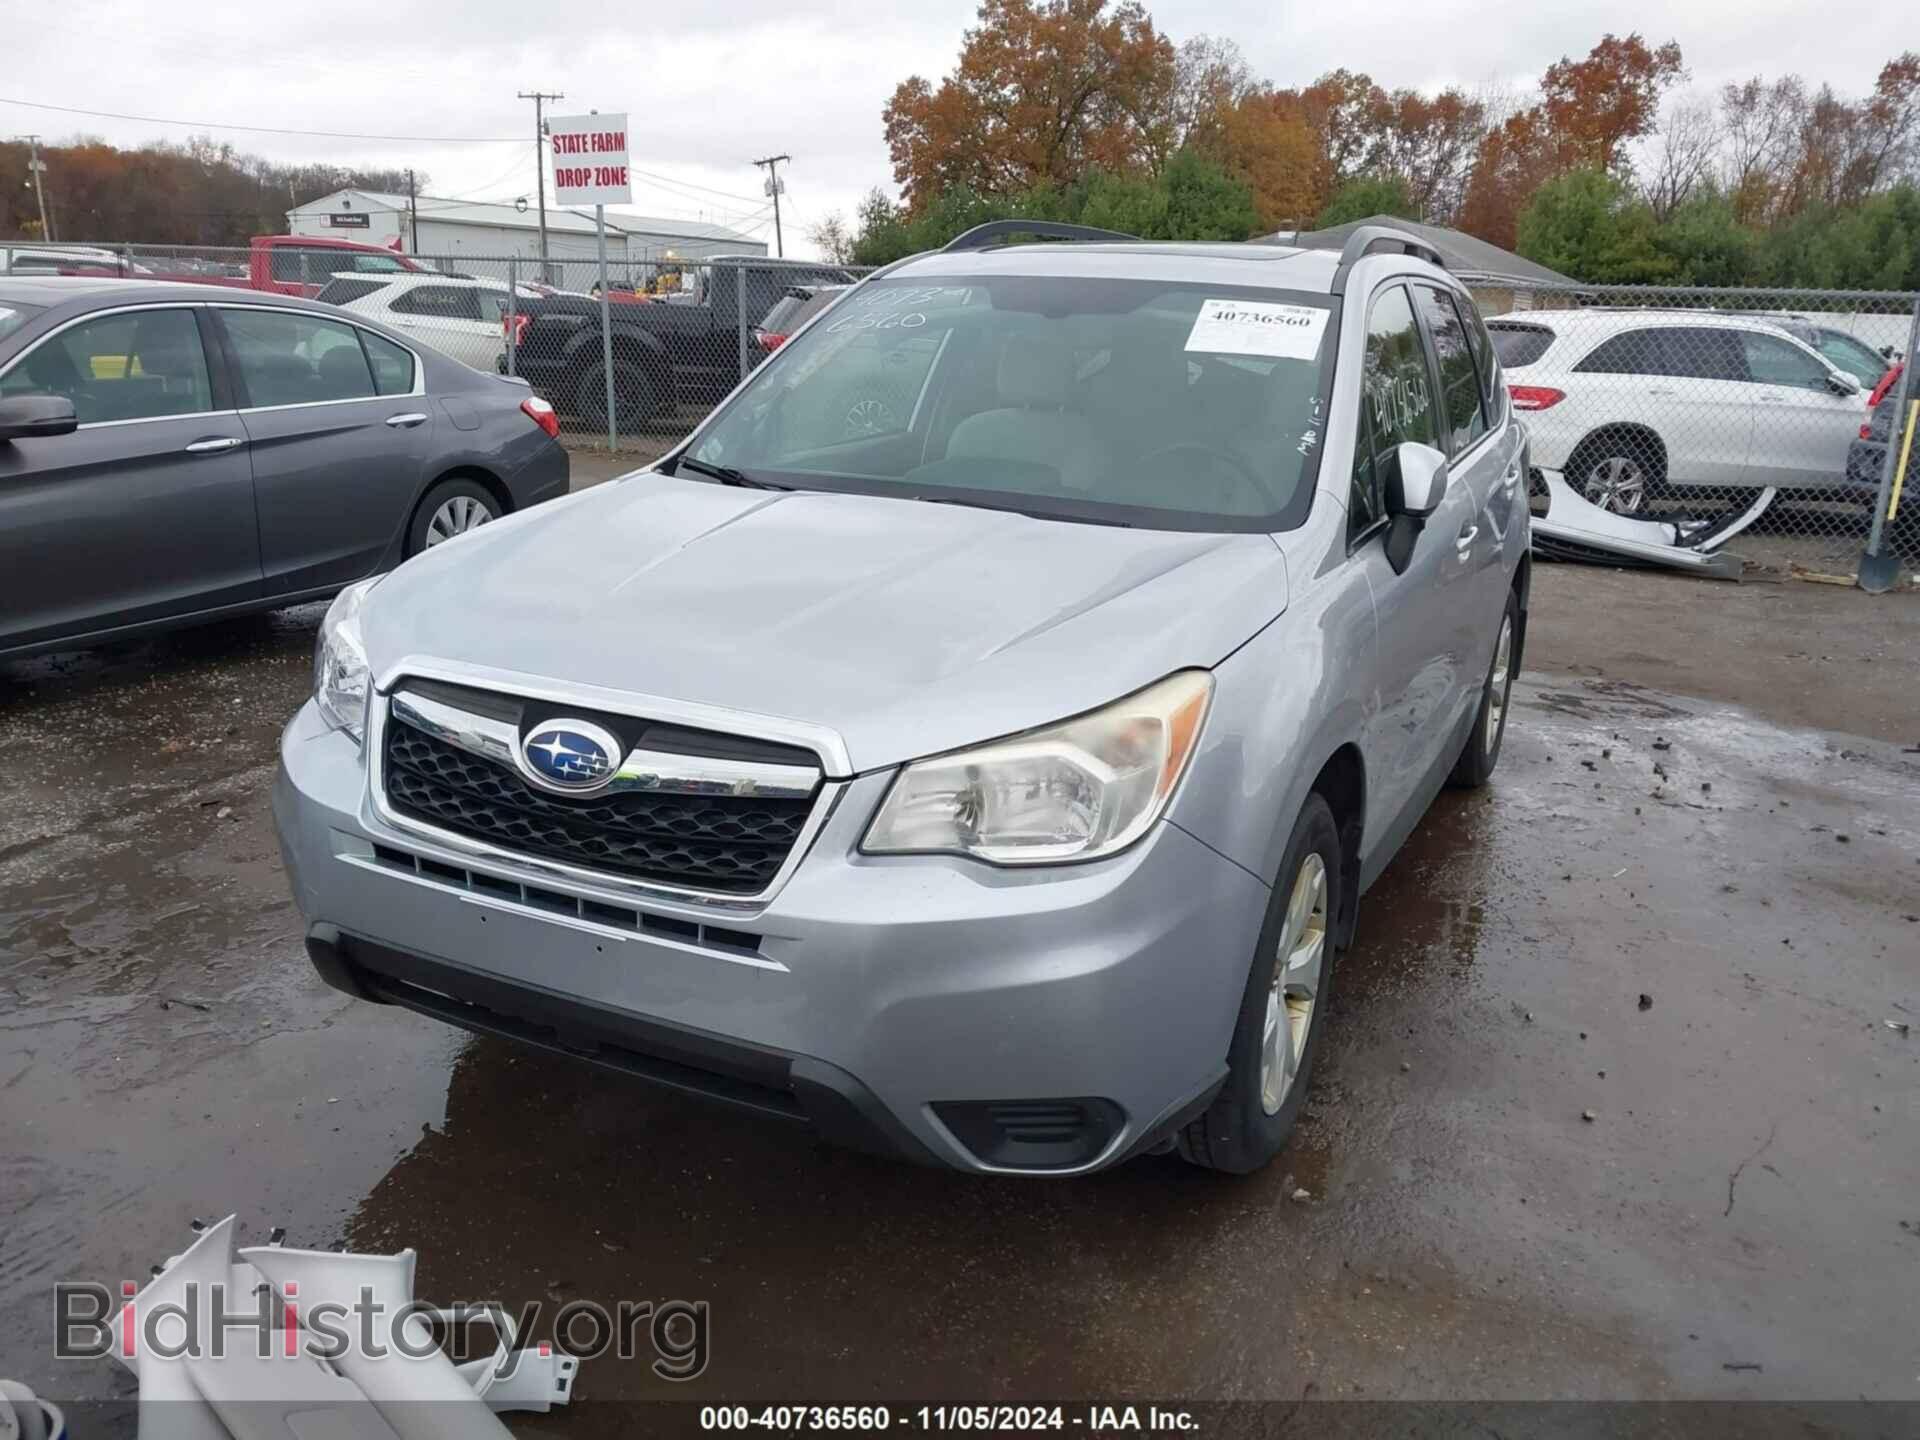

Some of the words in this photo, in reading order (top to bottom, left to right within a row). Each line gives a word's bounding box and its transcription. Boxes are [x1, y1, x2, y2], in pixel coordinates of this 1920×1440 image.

[552, 133, 589, 155] STATE
[590, 131, 626, 153] FARM
[556, 166, 592, 188] DROP
[594, 165, 628, 187] ZONE
[1210, 310, 1312, 328] 40736560
